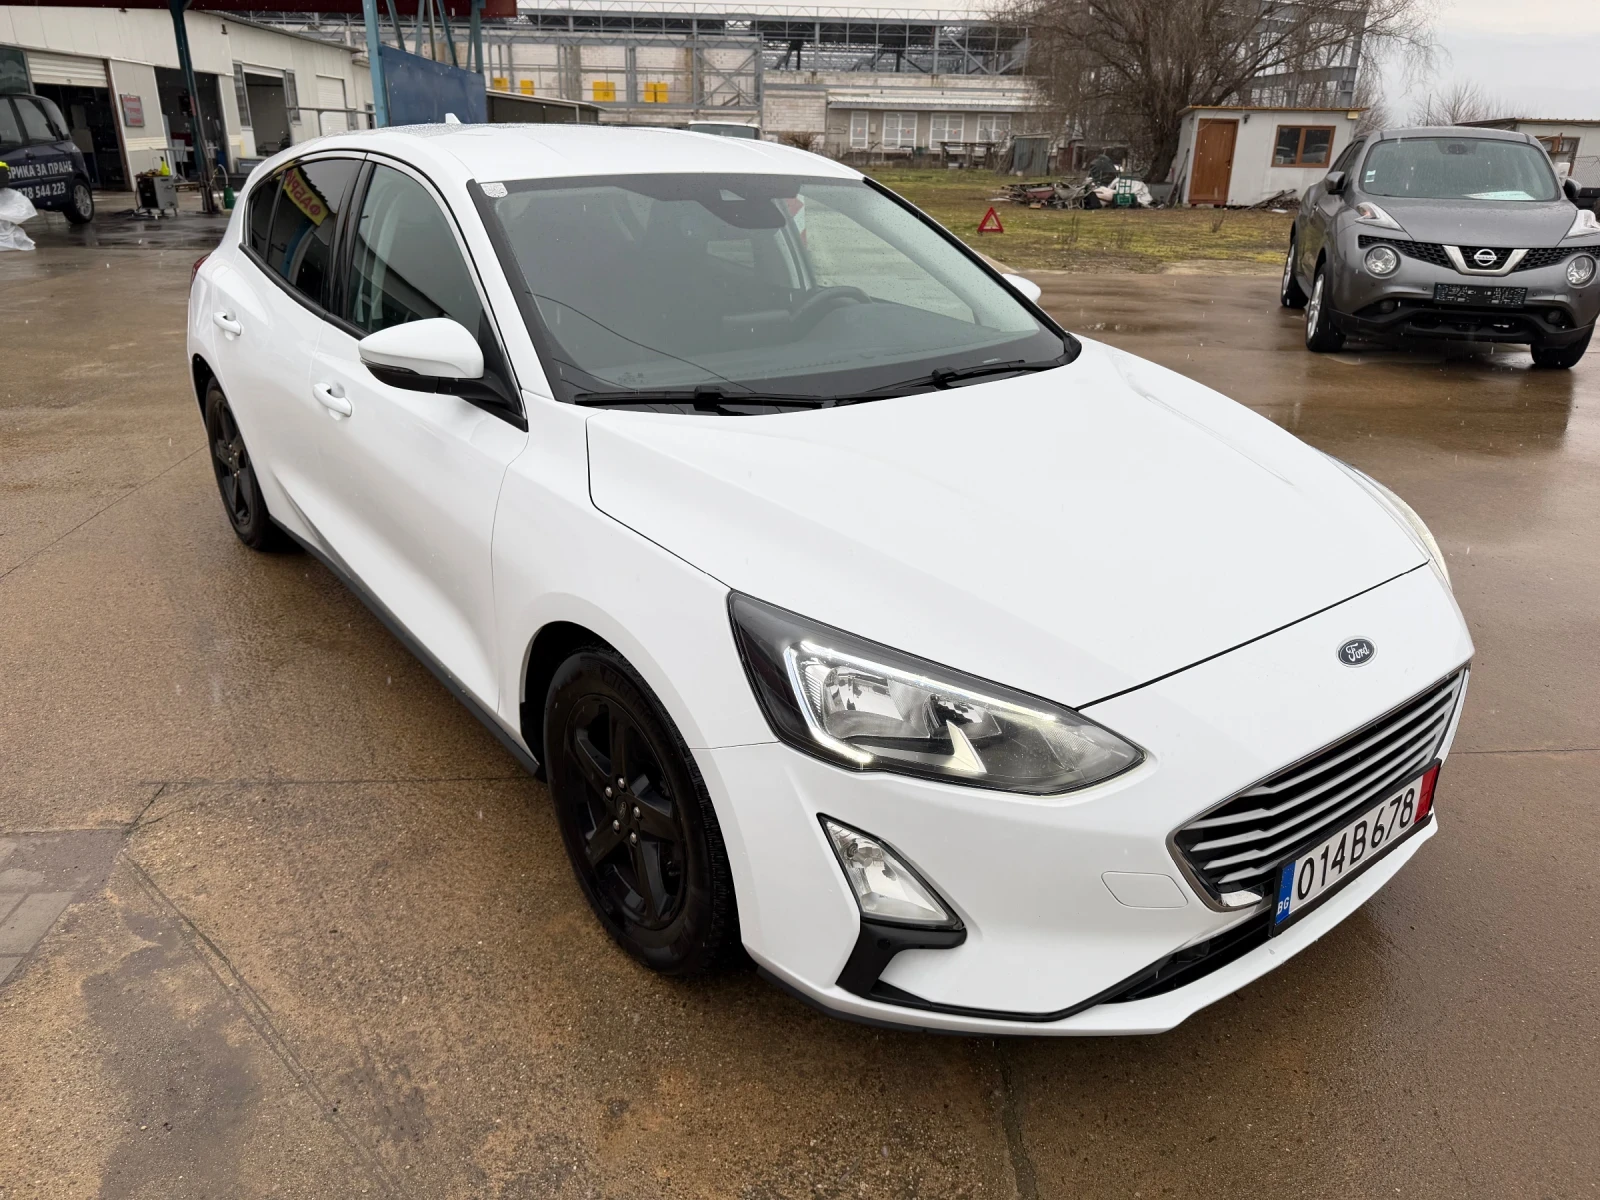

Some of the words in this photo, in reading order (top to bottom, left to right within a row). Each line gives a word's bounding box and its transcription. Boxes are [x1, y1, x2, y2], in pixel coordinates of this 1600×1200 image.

[36, 163, 48, 176] ЗА
[48, 160, 73, 174] ПРАНЕ
[35, 184, 51, 199] 544
[52, 181, 66, 195] 223
[1345, 642, 1370, 662] Ford
[1277, 896, 1290, 915] BG
